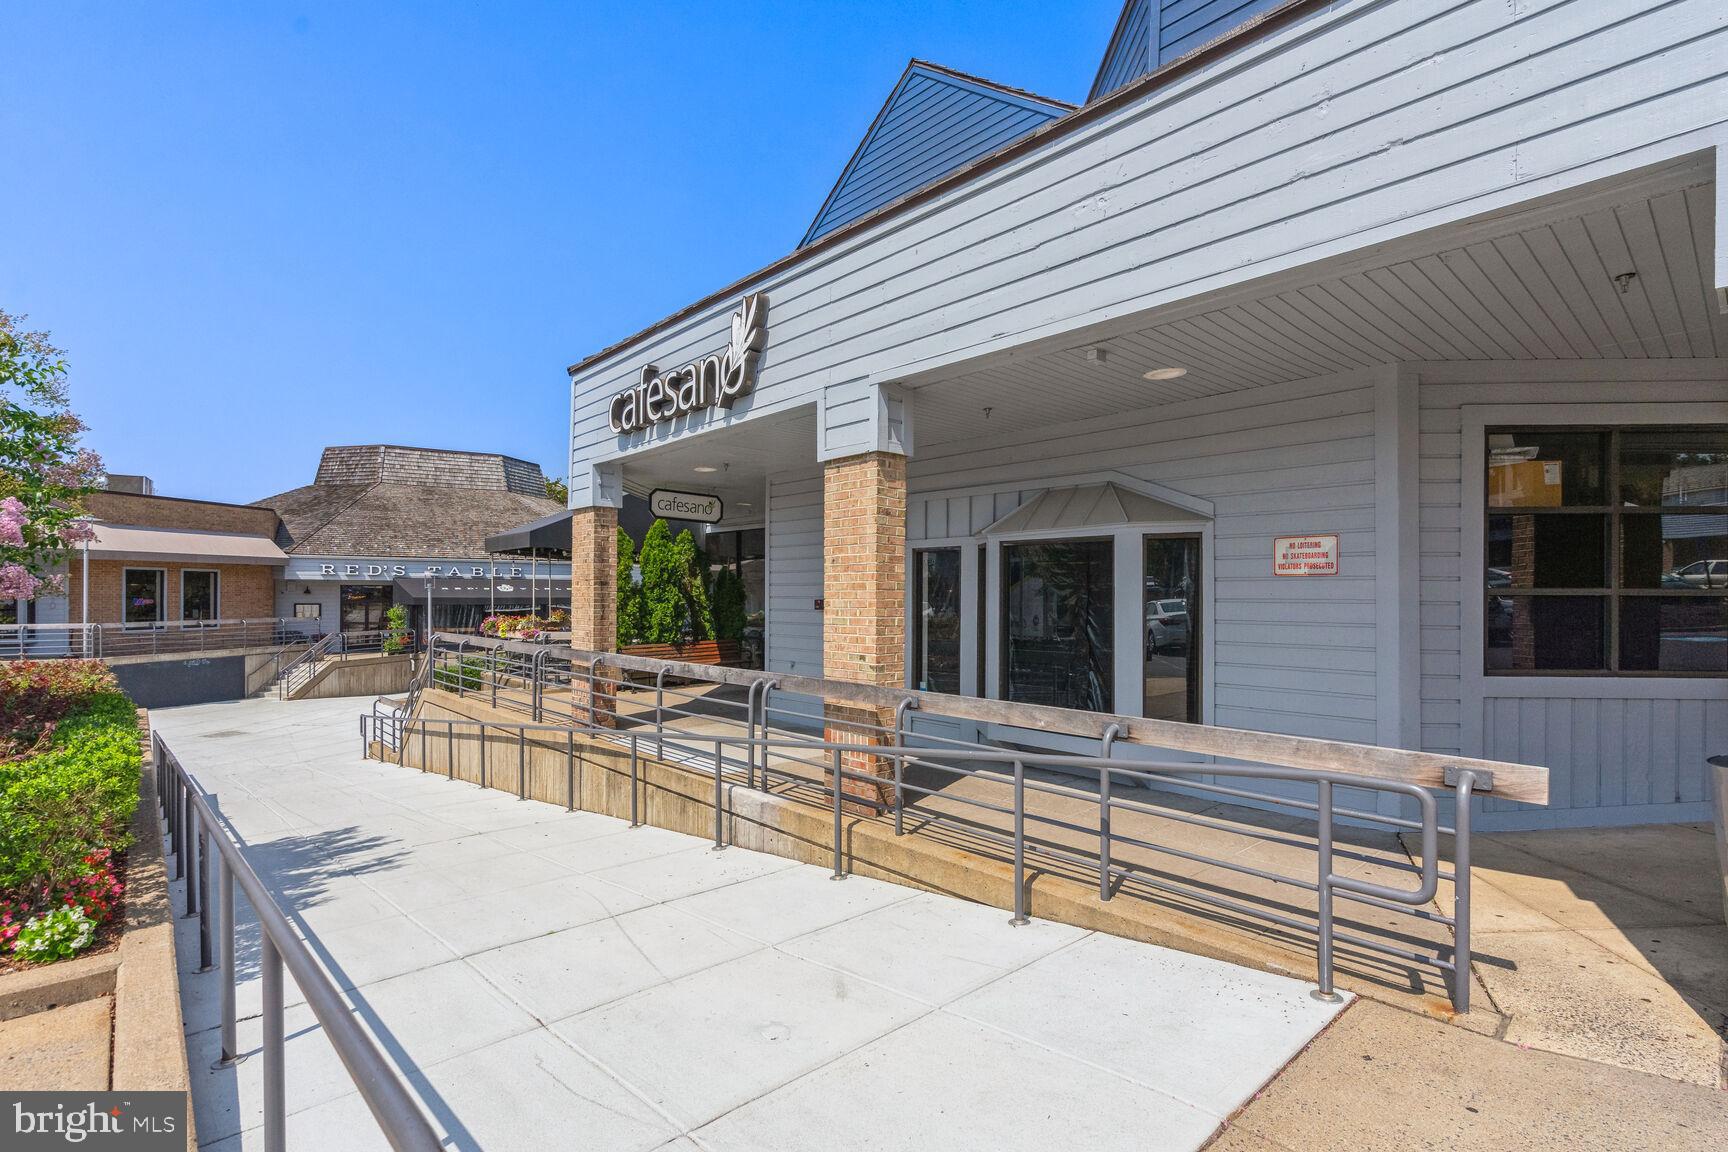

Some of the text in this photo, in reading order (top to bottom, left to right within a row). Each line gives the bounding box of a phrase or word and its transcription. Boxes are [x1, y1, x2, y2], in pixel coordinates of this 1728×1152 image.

[608, 340, 757, 433] cafesano
[658, 497, 713, 515] cafesano
[320, 564, 523, 577] RED'S TABLE
